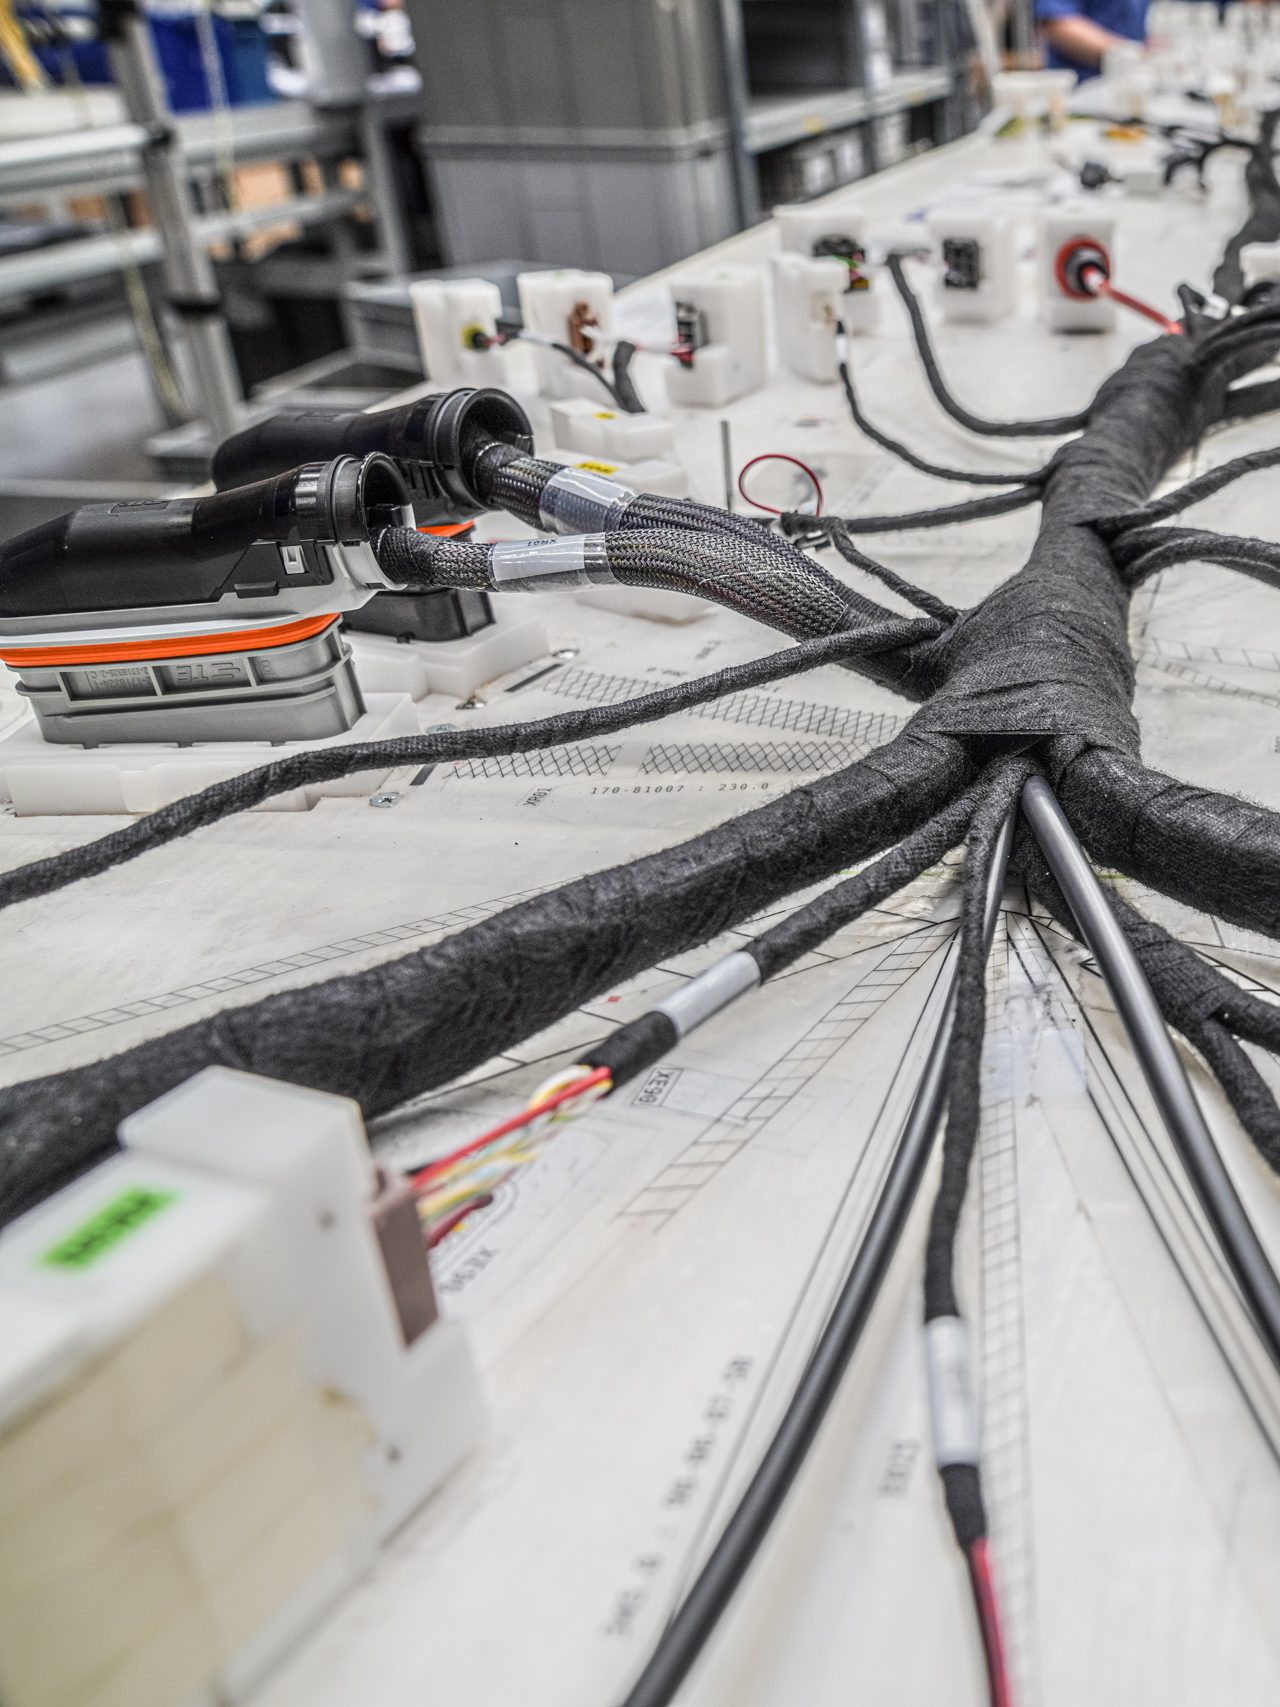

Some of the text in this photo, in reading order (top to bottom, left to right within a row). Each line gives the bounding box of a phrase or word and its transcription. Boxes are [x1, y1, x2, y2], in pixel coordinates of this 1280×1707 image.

[527, 538, 557, 547] XR01
[591, 784, 685, 795] 170-81007
[718, 782, 770, 792] 230.0
[523, 787, 552, 807] XR01
